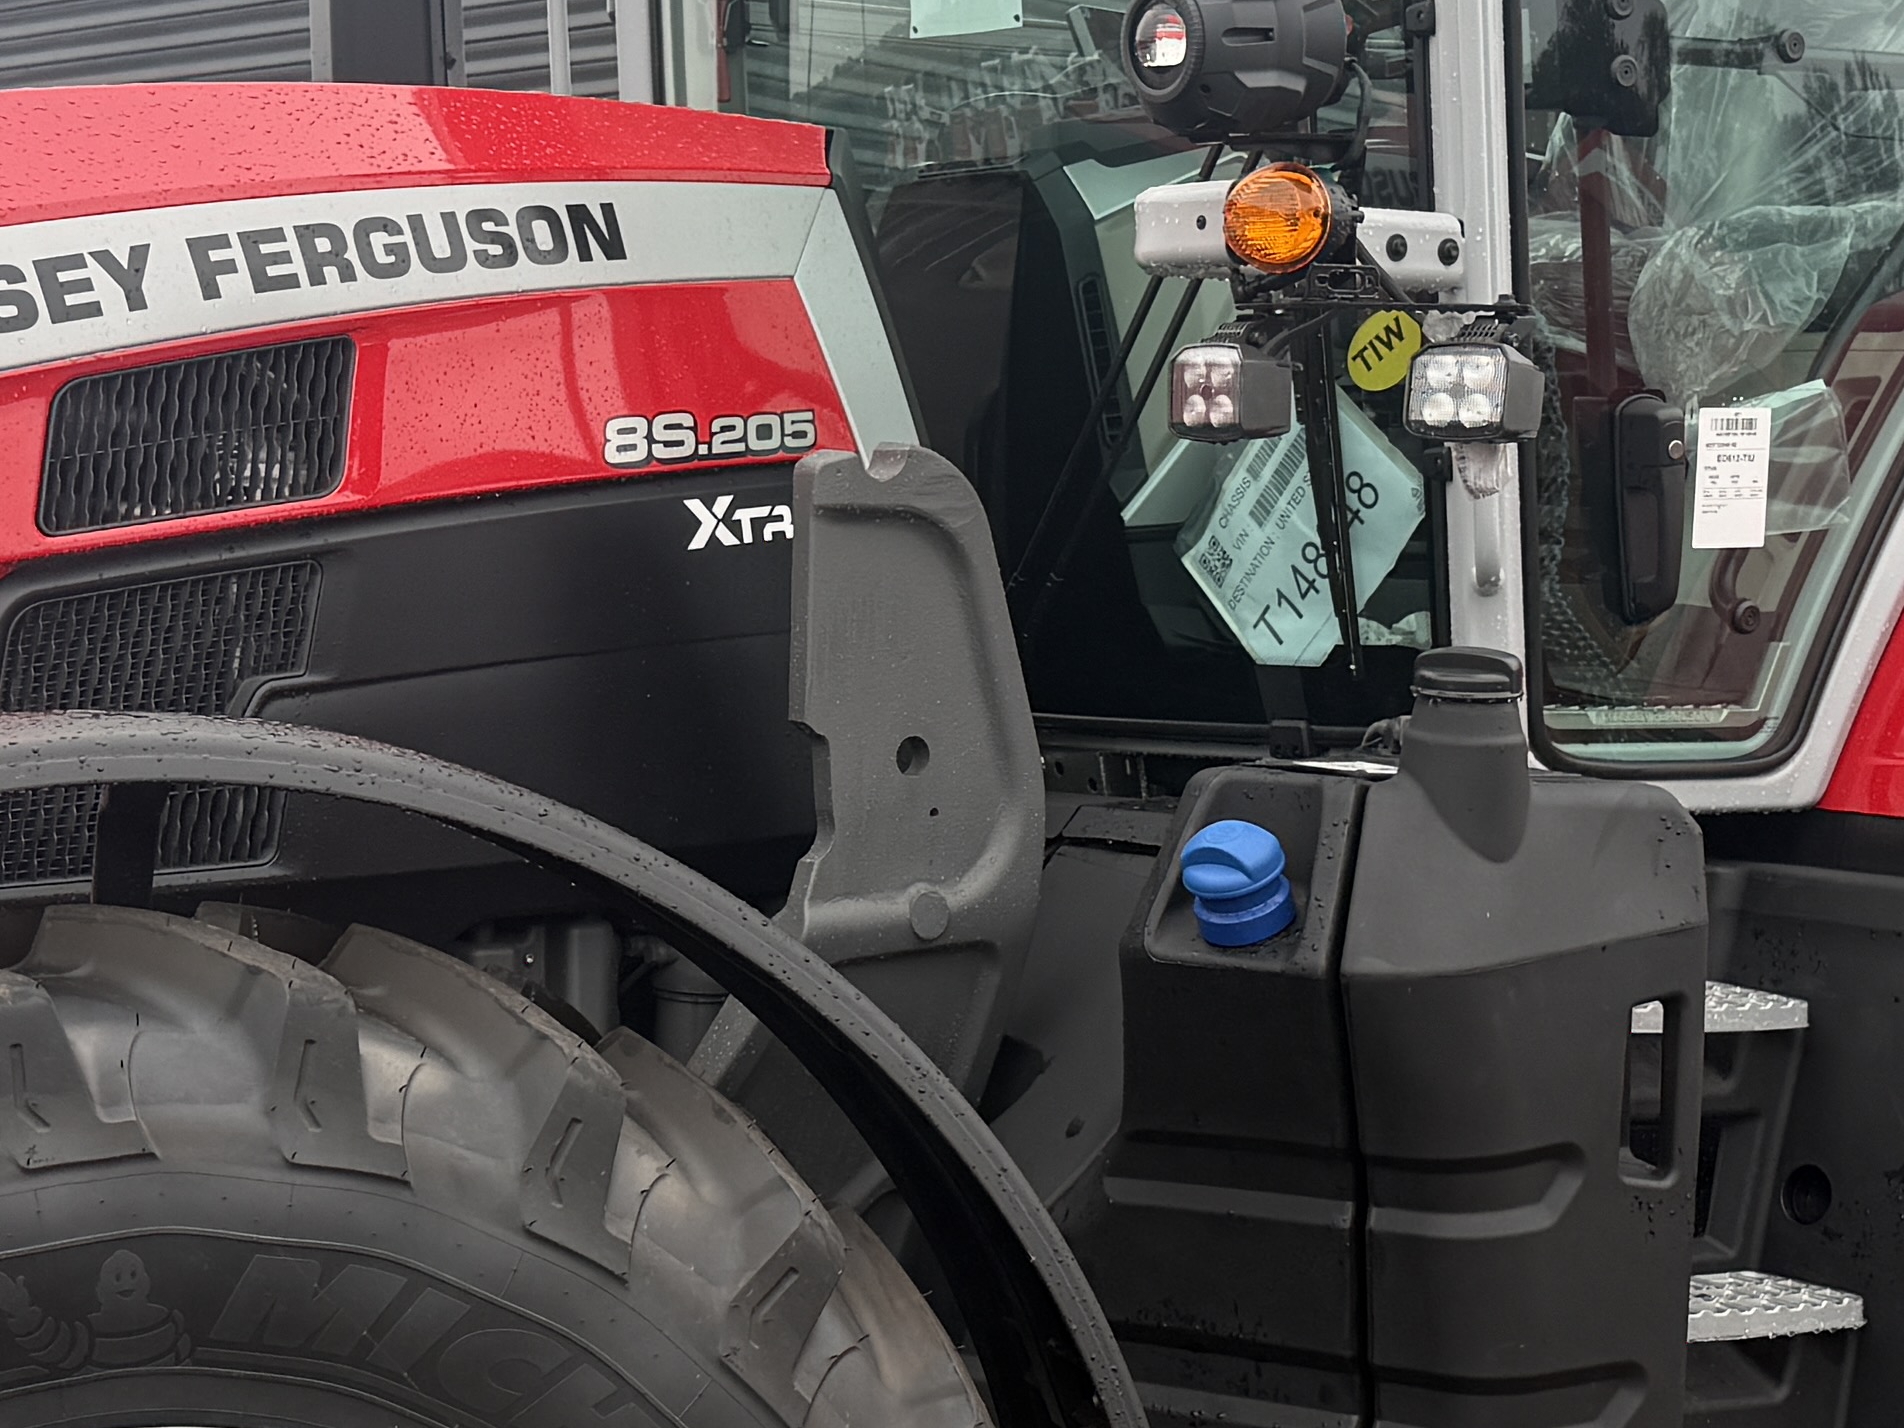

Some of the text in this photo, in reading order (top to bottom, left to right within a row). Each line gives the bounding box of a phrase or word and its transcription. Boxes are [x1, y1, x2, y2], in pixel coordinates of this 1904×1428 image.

[185, 201, 628, 302] FERGUSON
[1351, 314, 1405, 373] TIW
[603, 410, 818, 468] 8S.205
[1219, 476, 1251, 529] CHASSIS
[1227, 537, 1276, 612] DESTINATION
[1275, 487, 1307, 531] UNITED
[1233, 530, 1251, 552] VIN
[1253, 470, 1380, 647] T14848
